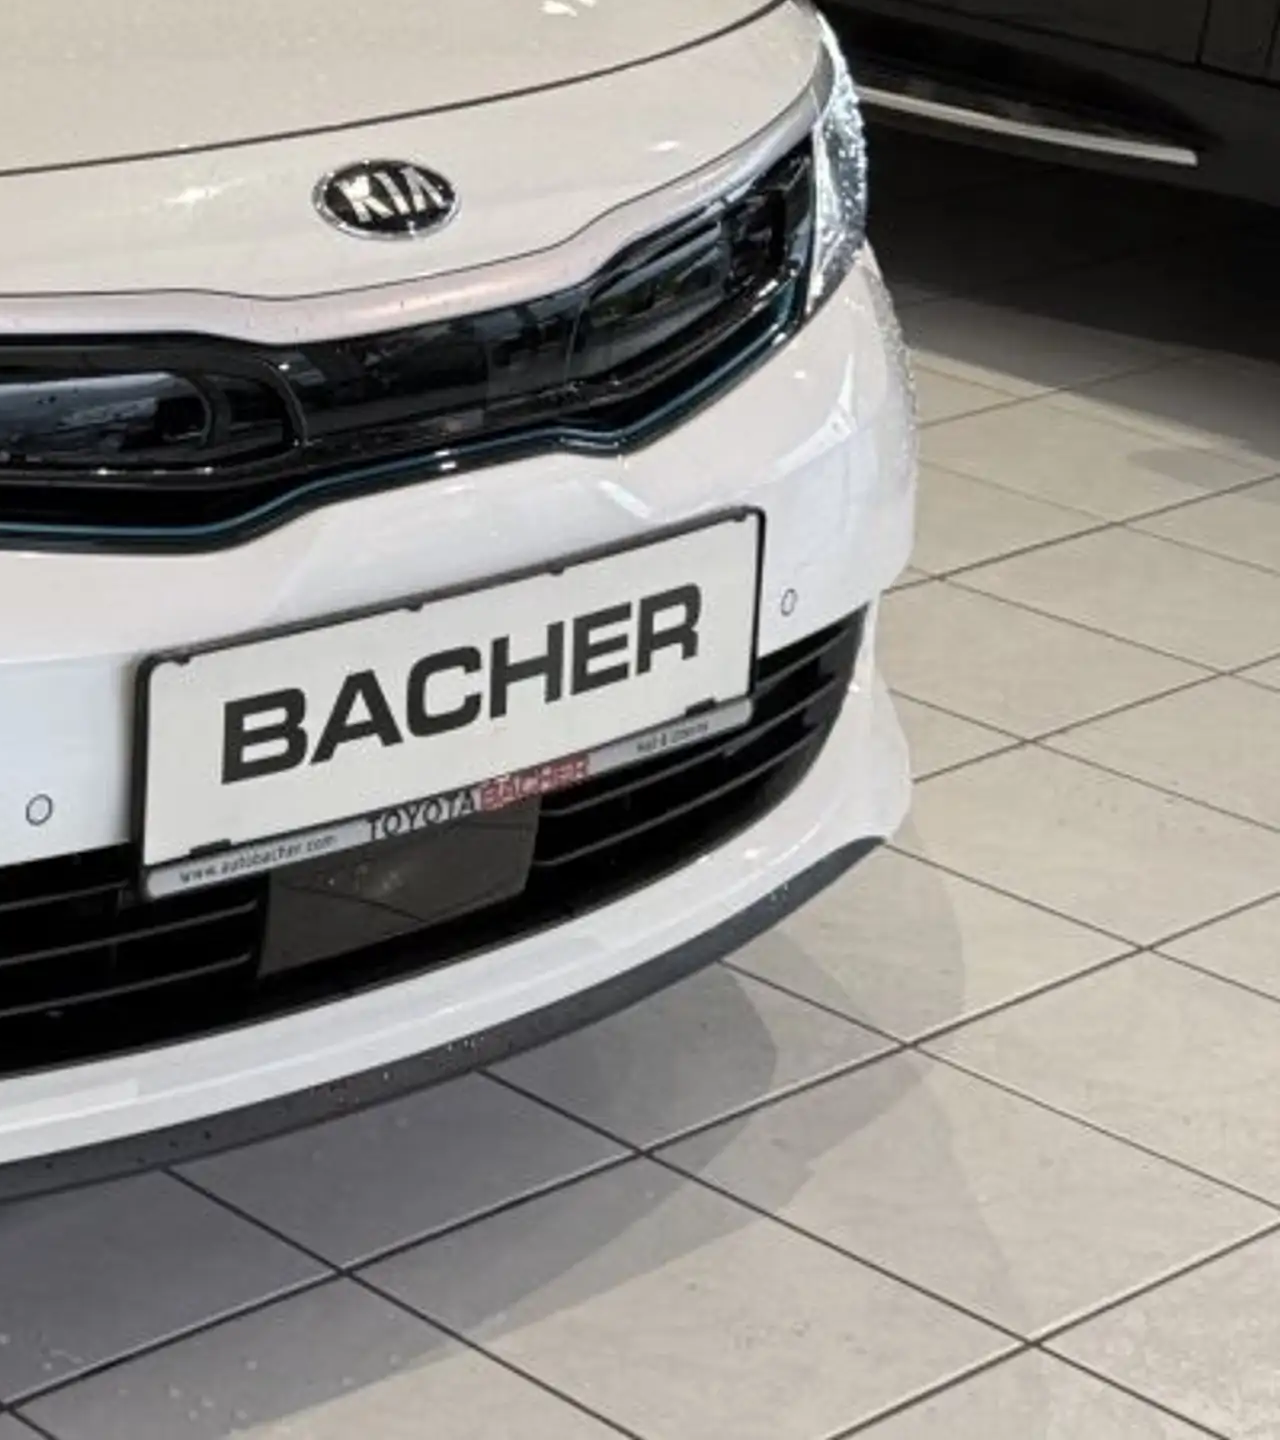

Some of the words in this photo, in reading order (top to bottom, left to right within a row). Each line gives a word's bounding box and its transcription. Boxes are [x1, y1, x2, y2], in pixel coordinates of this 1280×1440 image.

[337, 166, 447, 222] KIA
[221, 583, 701, 785] BACHER
[365, 790, 477, 840] TOYOTA
